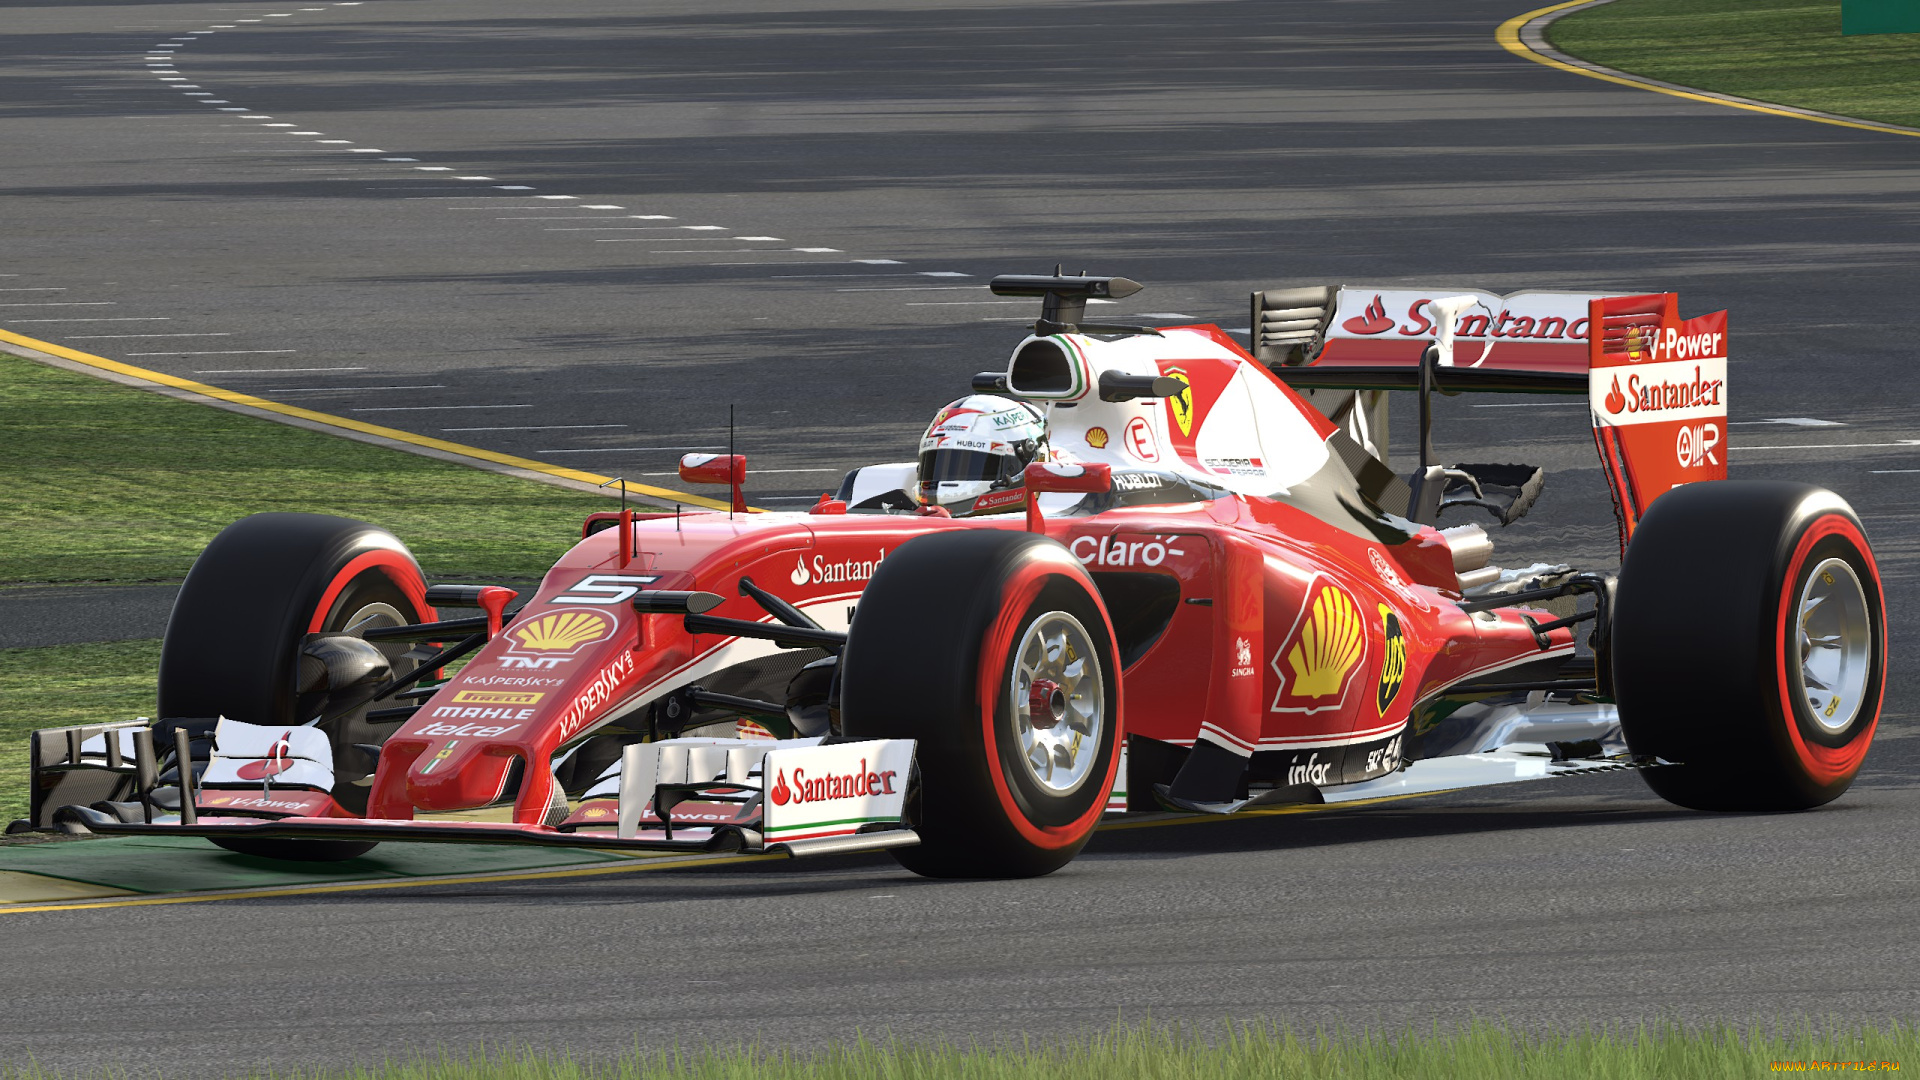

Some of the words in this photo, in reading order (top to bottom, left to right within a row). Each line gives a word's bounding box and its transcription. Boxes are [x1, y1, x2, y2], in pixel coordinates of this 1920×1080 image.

[1627, 365, 1723, 412] Santander
[957, 441, 985, 449] HUBLOT
[1131, 424, 1154, 458] E
[1112, 473, 1163, 491] HUBLOT
[988, 491, 1023, 505] Santander
[547, 574, 662, 605] 5
[497, 656, 575, 669] TNT
[1382, 635, 1406, 698] ups
[1231, 667, 1255, 677] SINGHA
[462, 675, 556, 687] KASPERSKY
[464, 692, 535, 703] PIRELLI
[558, 655, 626, 743] KASPERSKY
[431, 706, 536, 720] MAHLE
[413, 721, 522, 737] telcel
[1288, 753, 1332, 785] infor
[1365, 748, 1385, 773] SKF
[792, 758, 897, 804] Santander
[228, 797, 310, 809] V-Power
